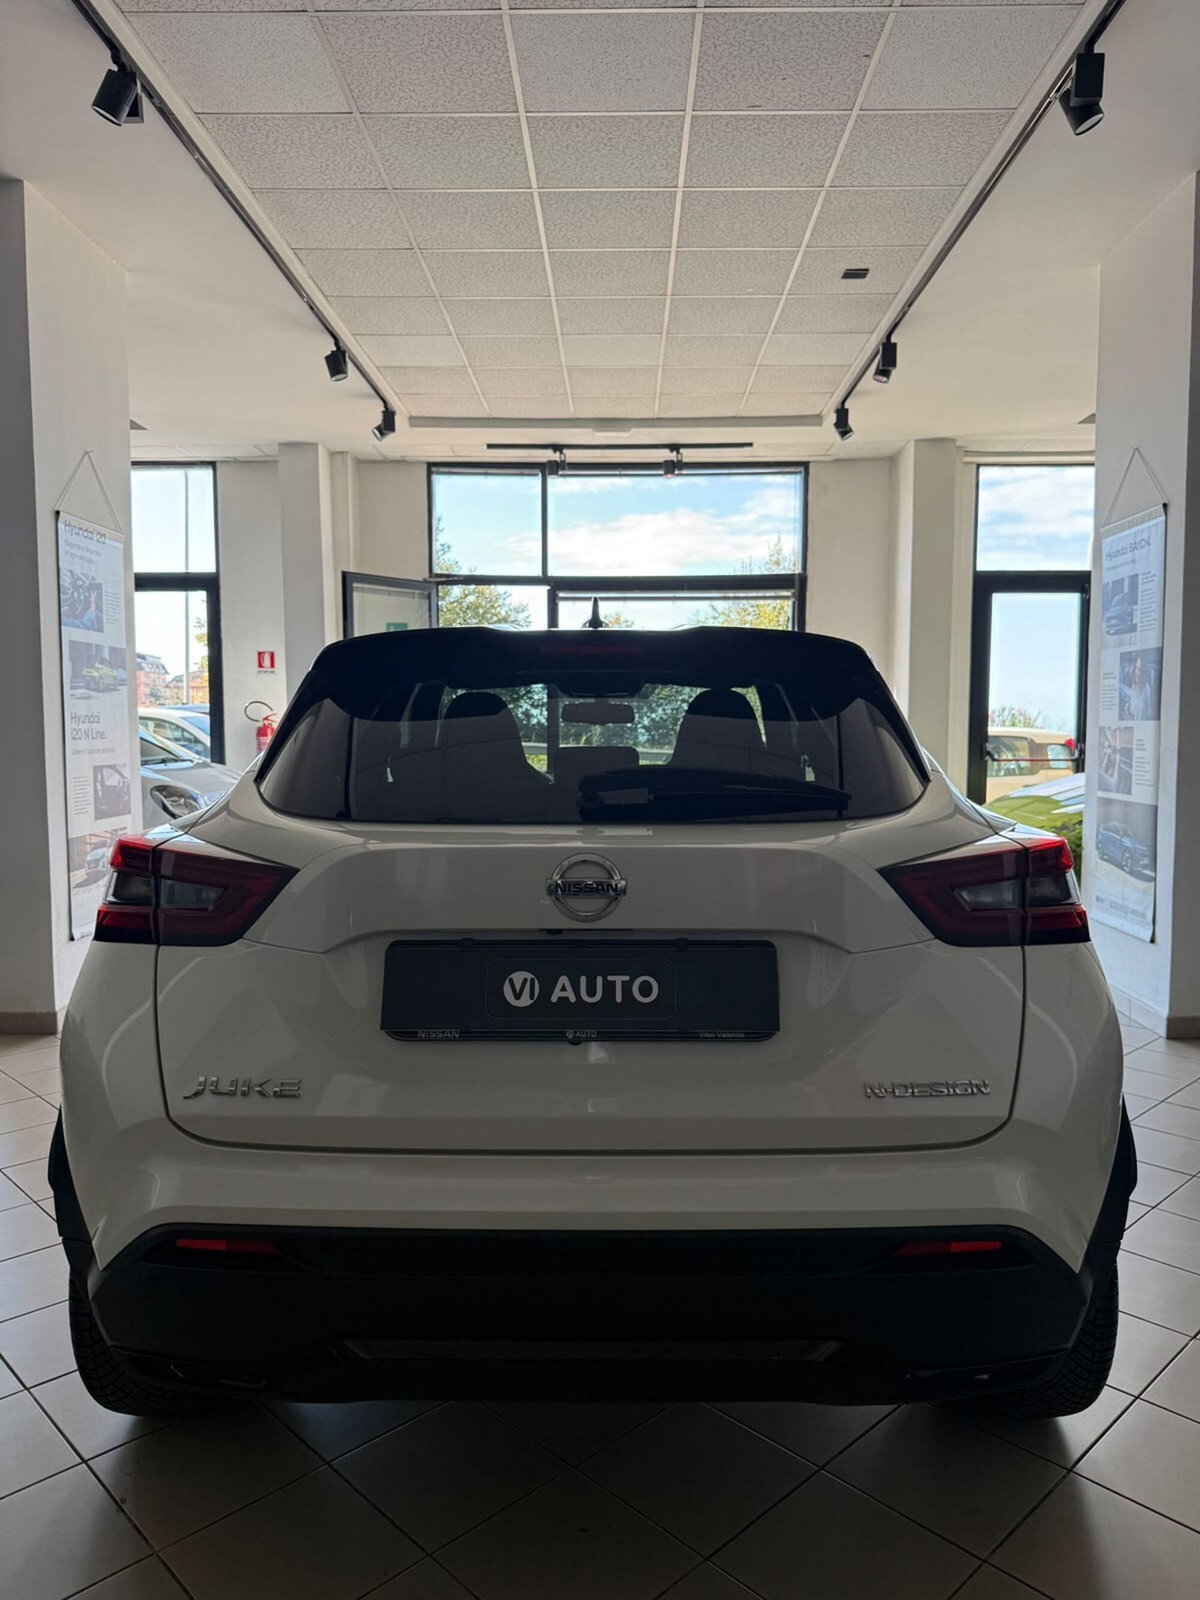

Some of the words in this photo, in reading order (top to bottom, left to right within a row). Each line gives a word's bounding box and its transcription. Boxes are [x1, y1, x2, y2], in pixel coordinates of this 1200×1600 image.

[64, 519, 95, 541] Hyundai
[95, 530, 108, 546] i20
[70, 711, 101, 727] Hyundai
[70, 727, 83, 741] i20
[84, 728, 90, 741] N
[91, 727, 108, 741] Line.
[555, 882, 619, 894] NISSAN
[550, 975, 660, 1003] AUTO
[417, 1029, 460, 1038] NISSAN
[575, 1030, 597, 1038] AUTO
[182, 1075, 302, 1100] JUKE
[864, 1079, 991, 1098] N-DESIGN
